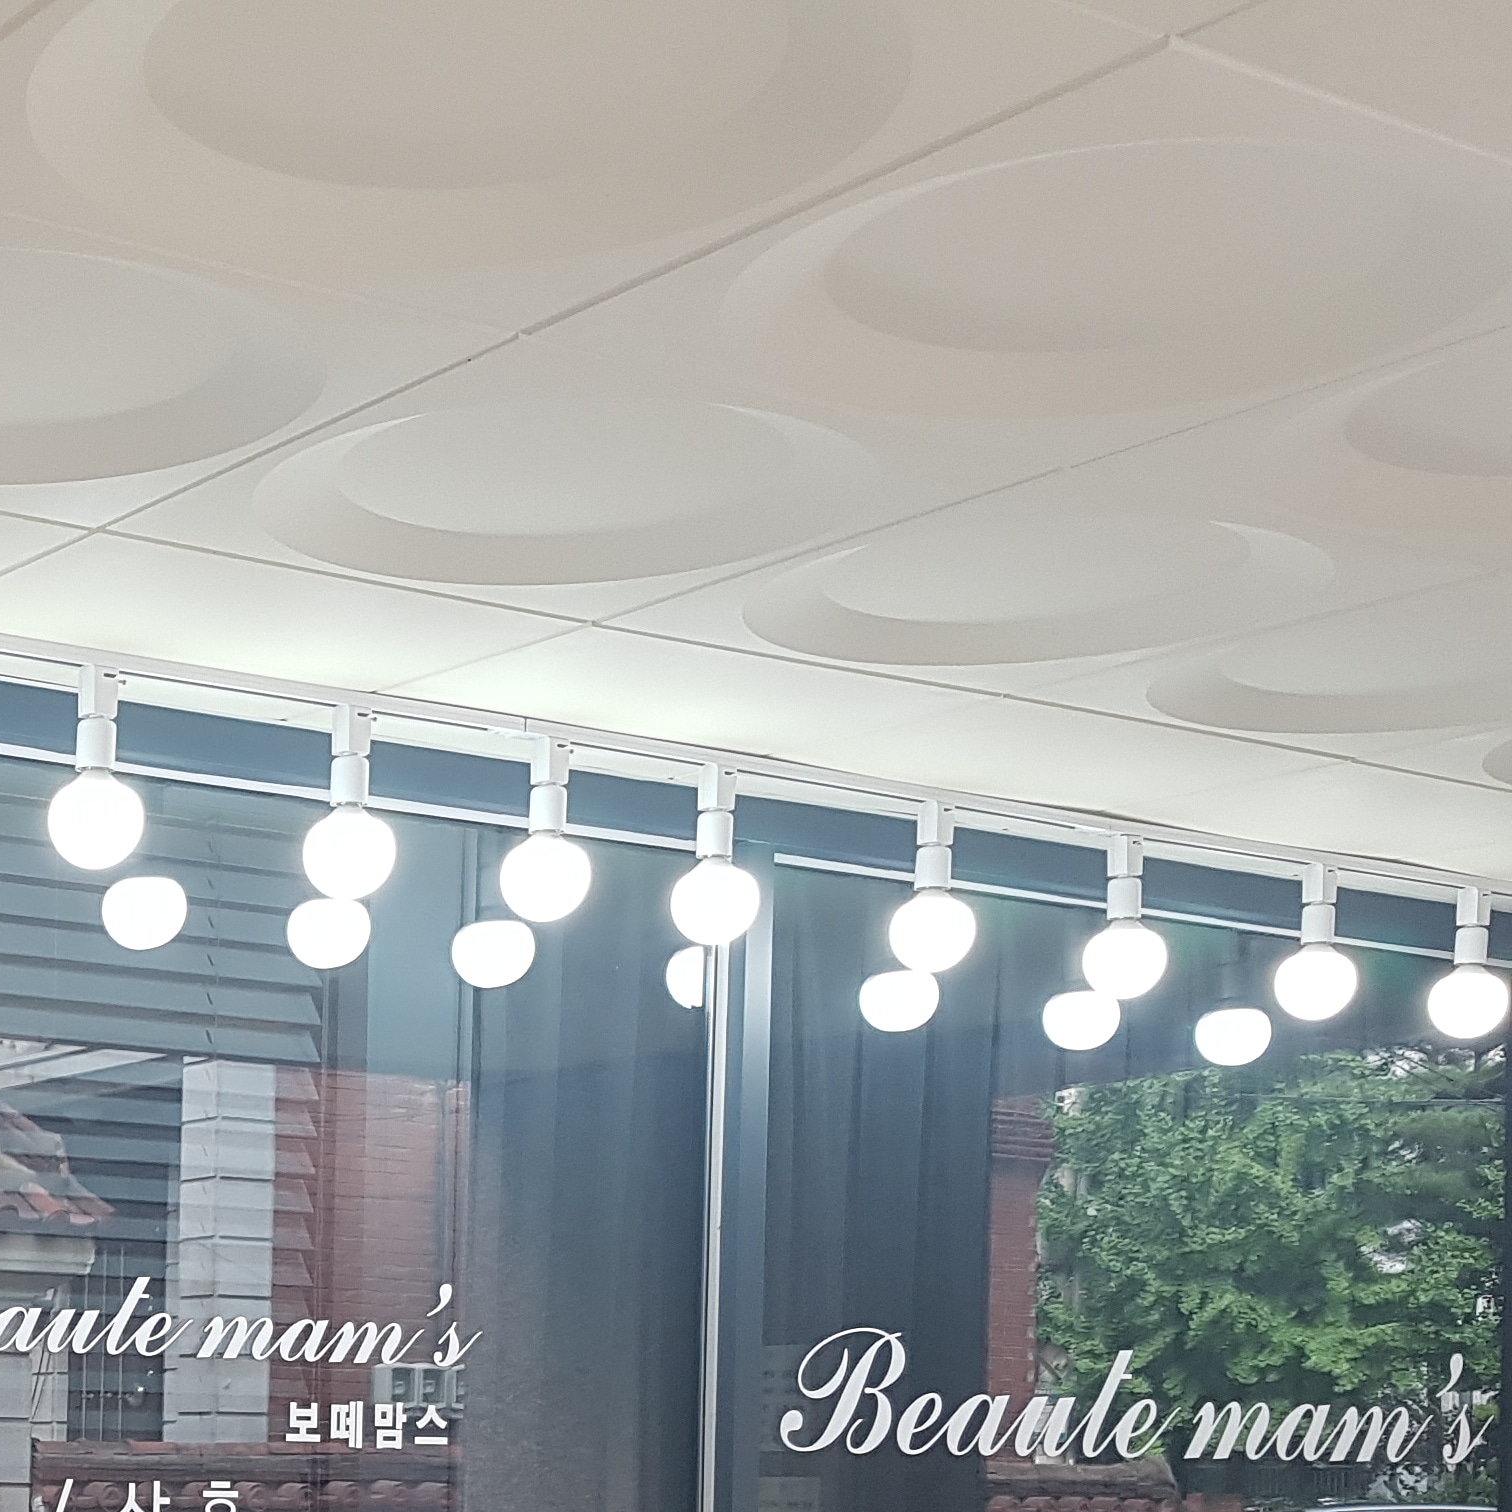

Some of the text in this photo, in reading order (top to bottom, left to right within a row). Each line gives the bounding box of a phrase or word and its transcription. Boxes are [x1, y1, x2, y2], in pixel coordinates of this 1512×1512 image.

[196, 1283, 483, 1367] mam's
[285, 1400, 448, 1450] 보떼맘스
[780, 1327, 1183, 1456] Beaute
[1183, 1352, 1495, 1464] mam's
